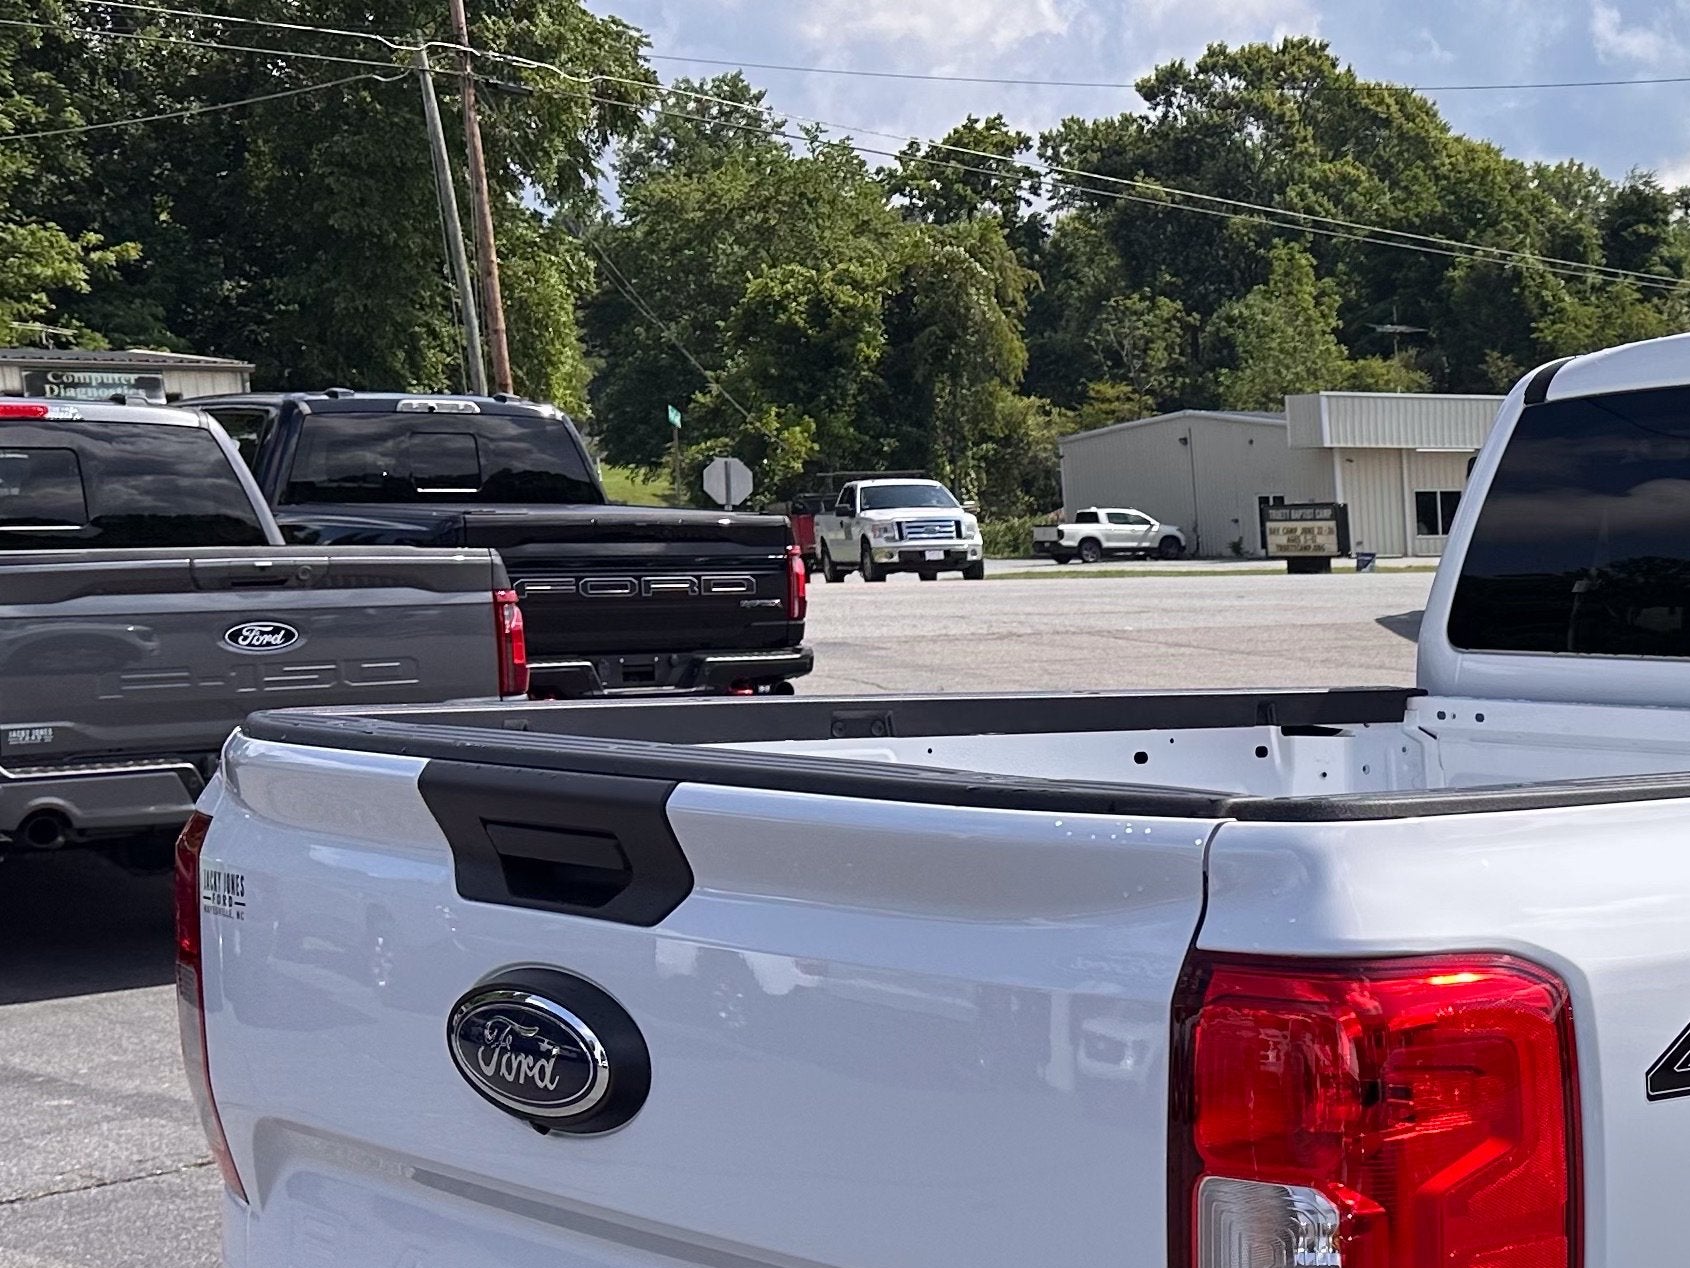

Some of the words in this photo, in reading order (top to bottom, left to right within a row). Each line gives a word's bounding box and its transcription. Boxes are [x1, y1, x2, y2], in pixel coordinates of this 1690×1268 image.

[47, 371, 137, 385] Computer
[44, 384, 146, 400] Diagnostics
[1282, 527, 1298, 535] CAMP
[513, 575, 757, 598] FORD
[236, 625, 287, 648] Ford
[203, 869, 221, 893] JACKY
[223, 872, 245, 897] JONES
[211, 892, 233, 908] FORD
[476, 1014, 561, 1091] Ford
